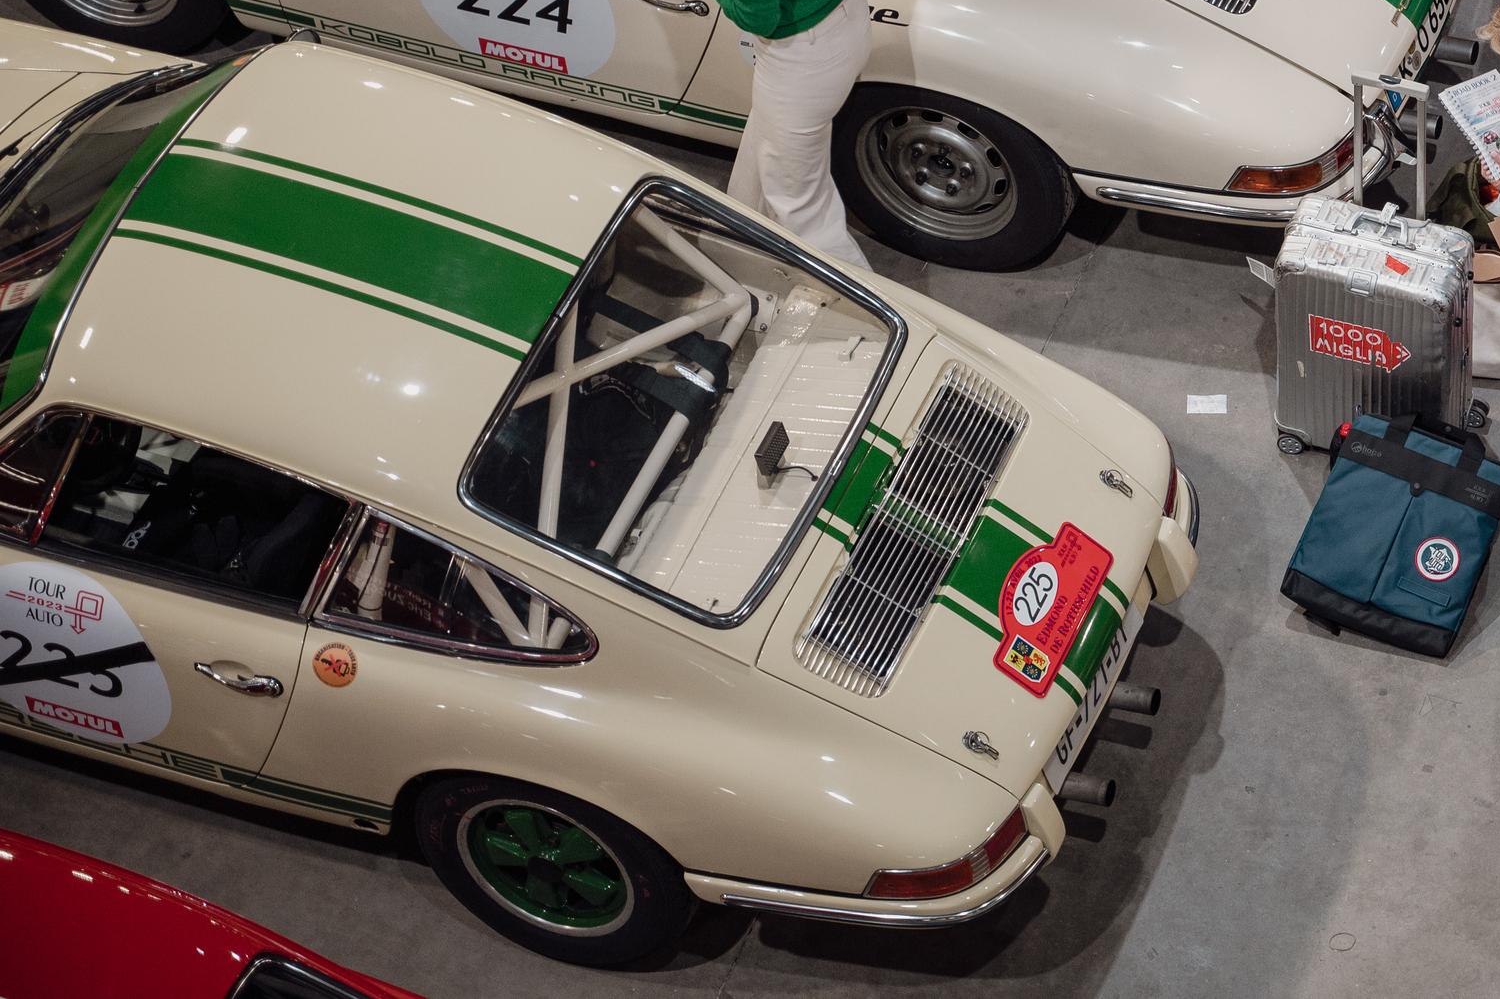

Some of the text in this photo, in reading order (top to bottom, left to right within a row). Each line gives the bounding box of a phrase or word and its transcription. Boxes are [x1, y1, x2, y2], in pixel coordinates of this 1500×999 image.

[320, 19, 656, 109] KOBOLD RACING
[484, 41, 564, 72] MOTUL
[1453, 85, 1472, 97] ROAD
[1472, 79, 1491, 91] BOOK
[1319, 322, 1381, 345] 1000
[1316, 337, 1387, 364] MIGLIA
[28, 576, 66, 600] TOUR
[1014, 567, 1053, 623] 225
[26, 608, 63, 627] AUTO
[27, 596, 63, 611] 2023
[1050, 565, 1100, 655] DE ROTHSCHILD
[1036, 594, 1069, 646] EDMOND
[33, 701, 119, 735] MOTUL
